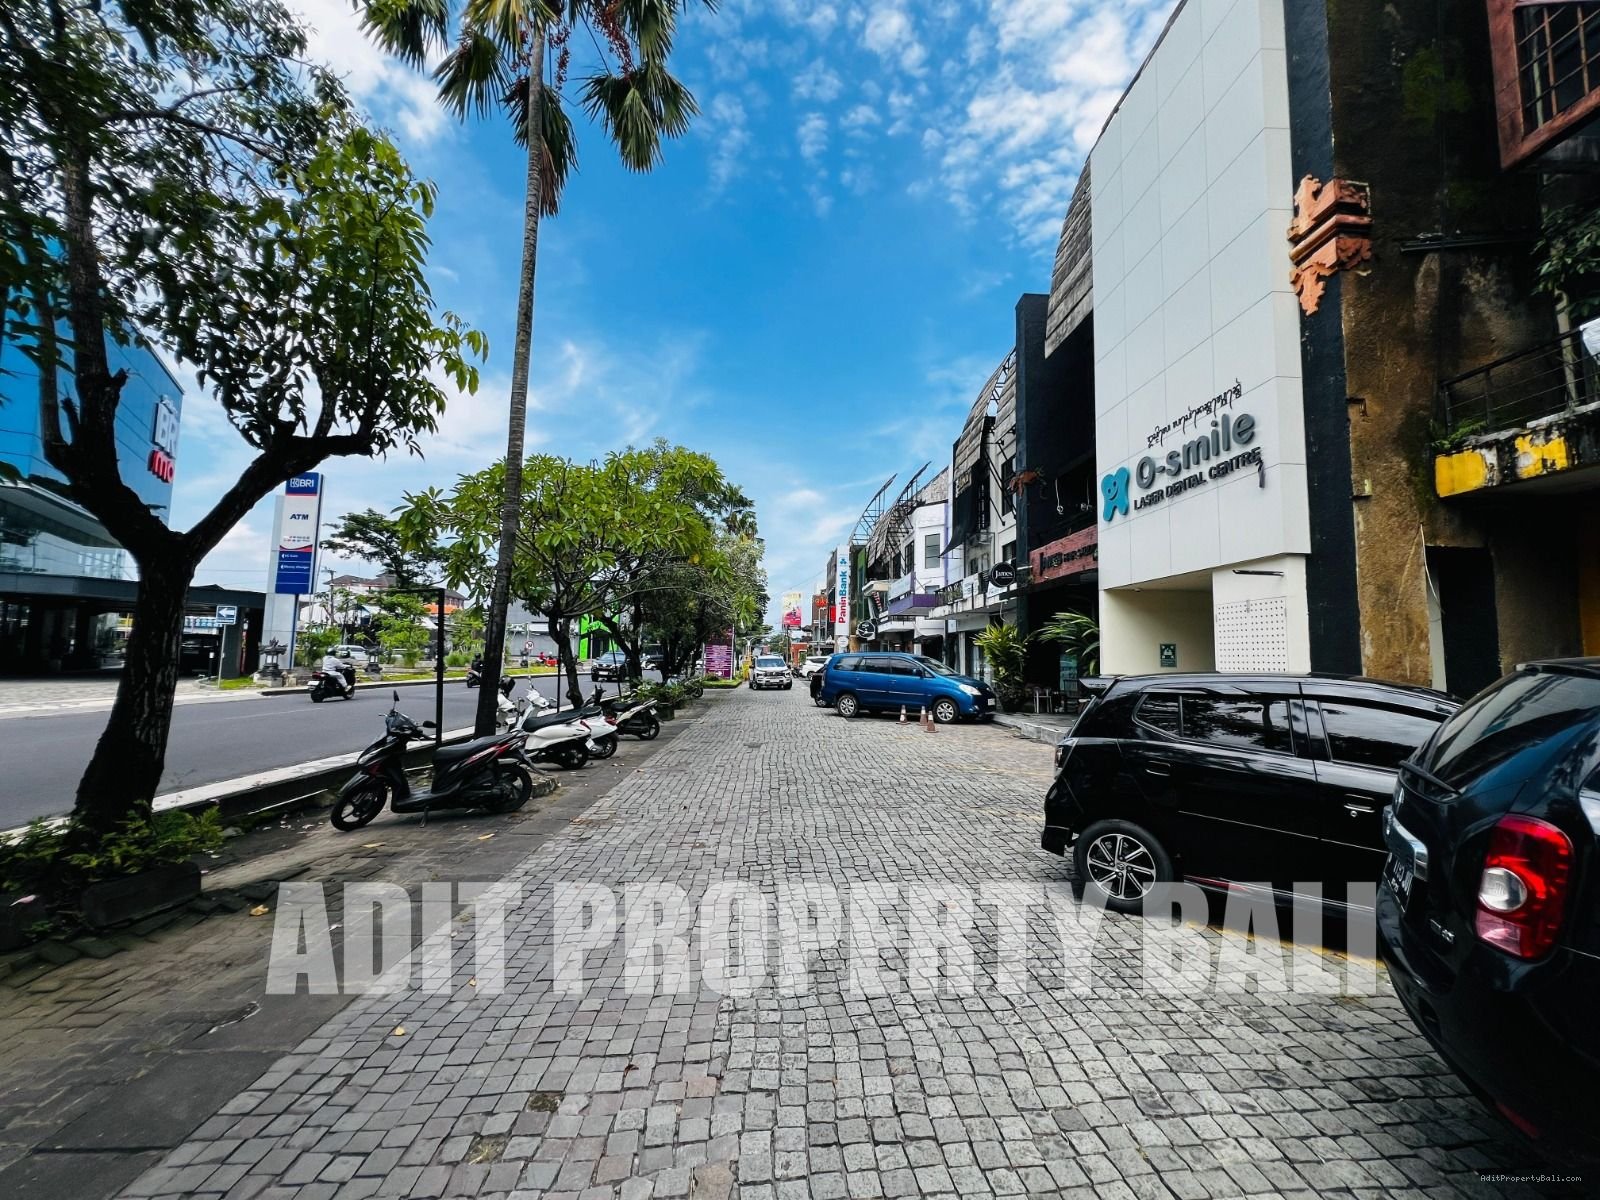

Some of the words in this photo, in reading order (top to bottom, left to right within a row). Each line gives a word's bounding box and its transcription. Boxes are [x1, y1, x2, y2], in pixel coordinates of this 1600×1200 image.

[1135, 413, 1255, 489] O-smile
[299, 479, 315, 488] BRI
[1134, 488, 1164, 511] LASER
[1166, 472, 1208, 498] DENTAL
[1209, 447, 1262, 479] CENTRE
[290, 513, 309, 521] ATM
[838, 571, 848, 623] PaninBank
